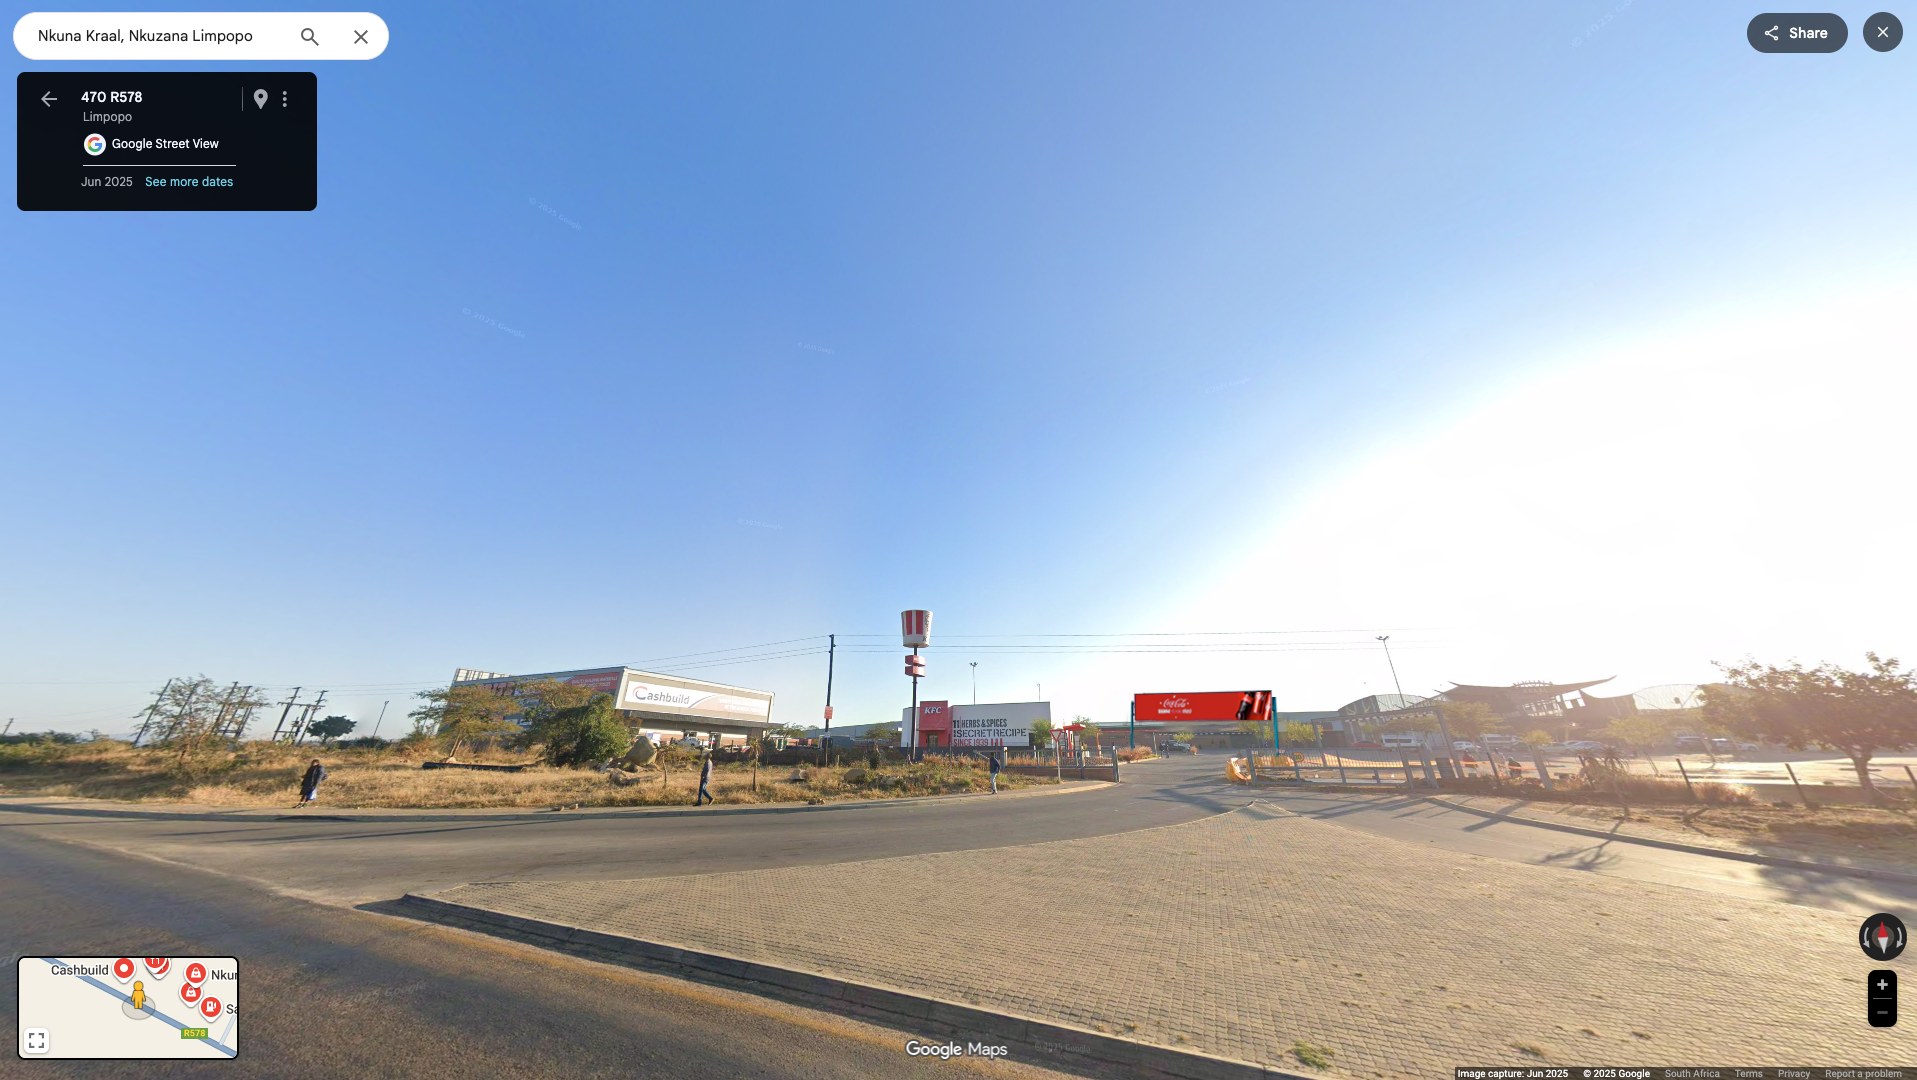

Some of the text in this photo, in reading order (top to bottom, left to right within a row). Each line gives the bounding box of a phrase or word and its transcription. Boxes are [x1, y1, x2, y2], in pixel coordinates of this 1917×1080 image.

[632, 685, 689, 704] Cashbuild
[924, 706, 942, 714] KFC
[961, 719, 980, 728] HERBS
[956, 729, 992, 738] SECRET
[993, 728, 1027, 737] RECIPE
[953, 738, 972, 747] SINCE
